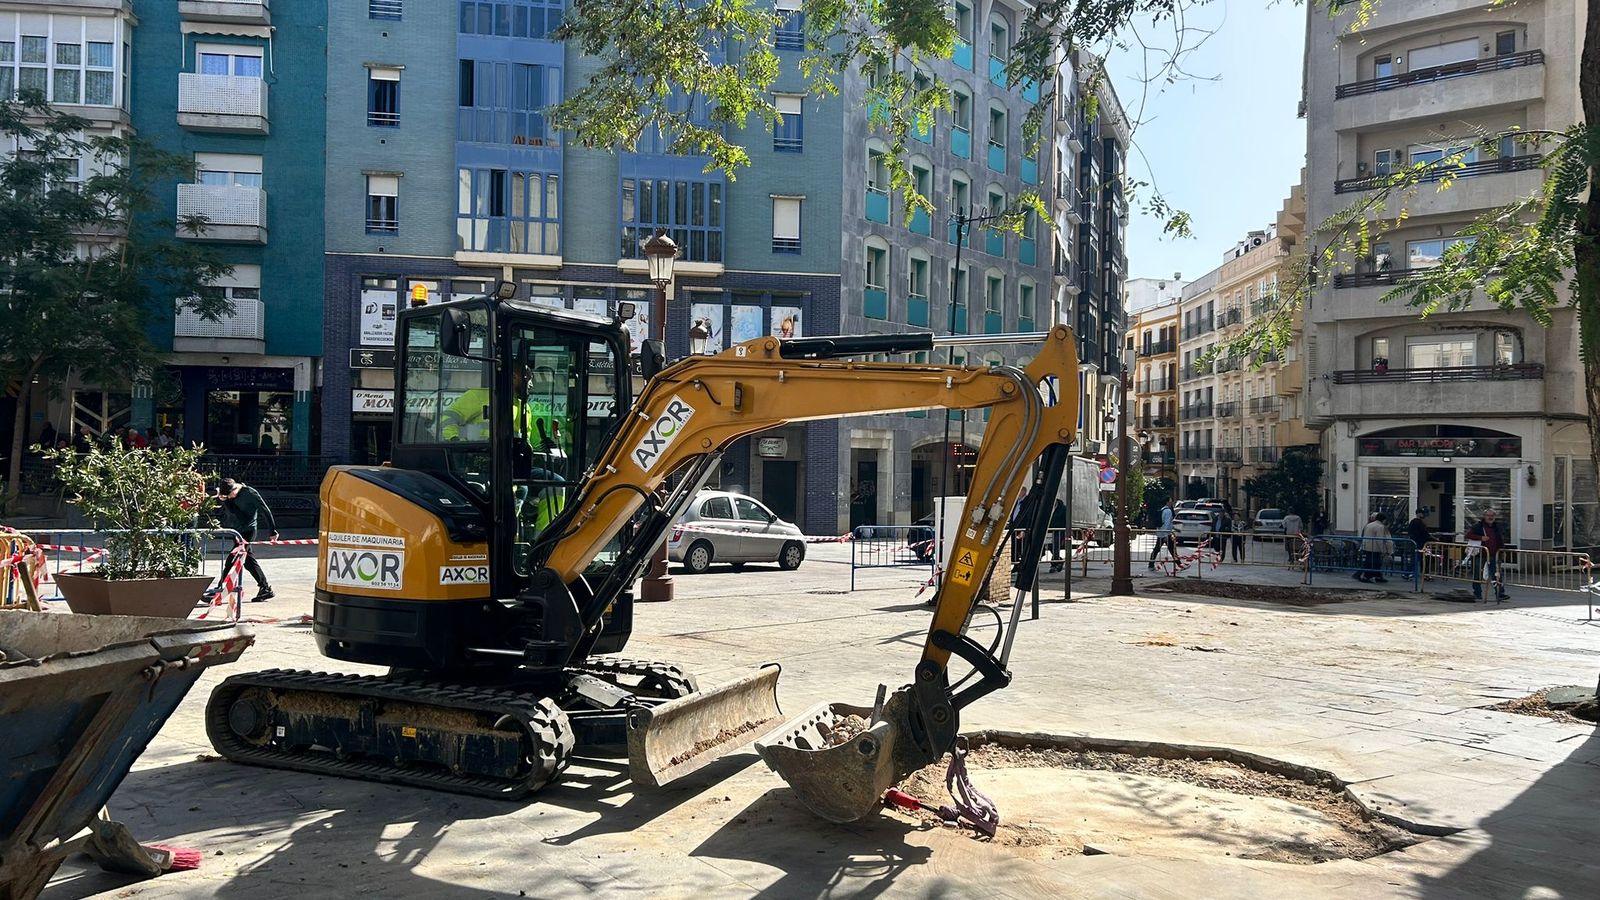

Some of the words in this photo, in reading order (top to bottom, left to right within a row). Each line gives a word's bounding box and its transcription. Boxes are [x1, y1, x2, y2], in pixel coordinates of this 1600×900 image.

[636, 400, 690, 468] AXOR
[352, 535, 360, 543] DE
[361, 536, 404, 546] MAQUINARIA
[328, 550, 400, 583] AXOR
[441, 567, 488, 582] AXOR
